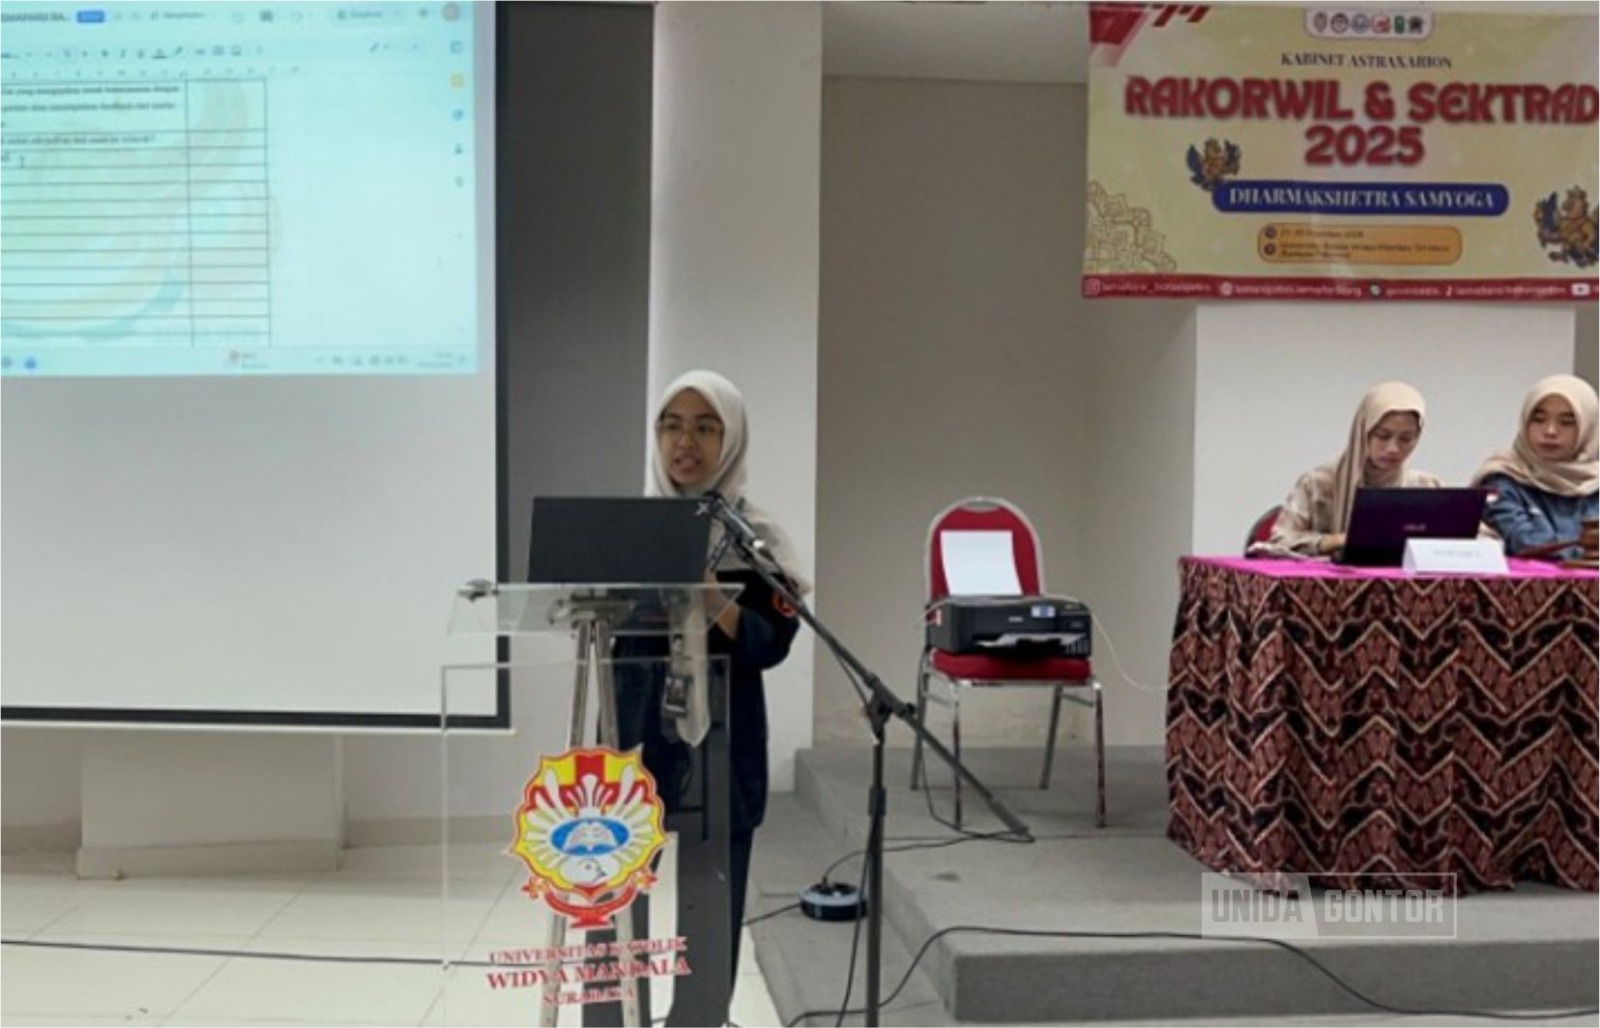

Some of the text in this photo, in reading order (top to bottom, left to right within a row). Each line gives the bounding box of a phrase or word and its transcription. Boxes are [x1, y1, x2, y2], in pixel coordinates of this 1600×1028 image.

[1281, 53, 1451, 69] KABINET ASTRAXARION
[1125, 76, 1598, 124] RAKORWIL & SEKTRAD
[1305, 126, 1425, 166] 2025
[1229, 187, 1493, 209] DHARMAKSHETRA SAMYOGA
[487, 967, 568, 991] WIDYA
